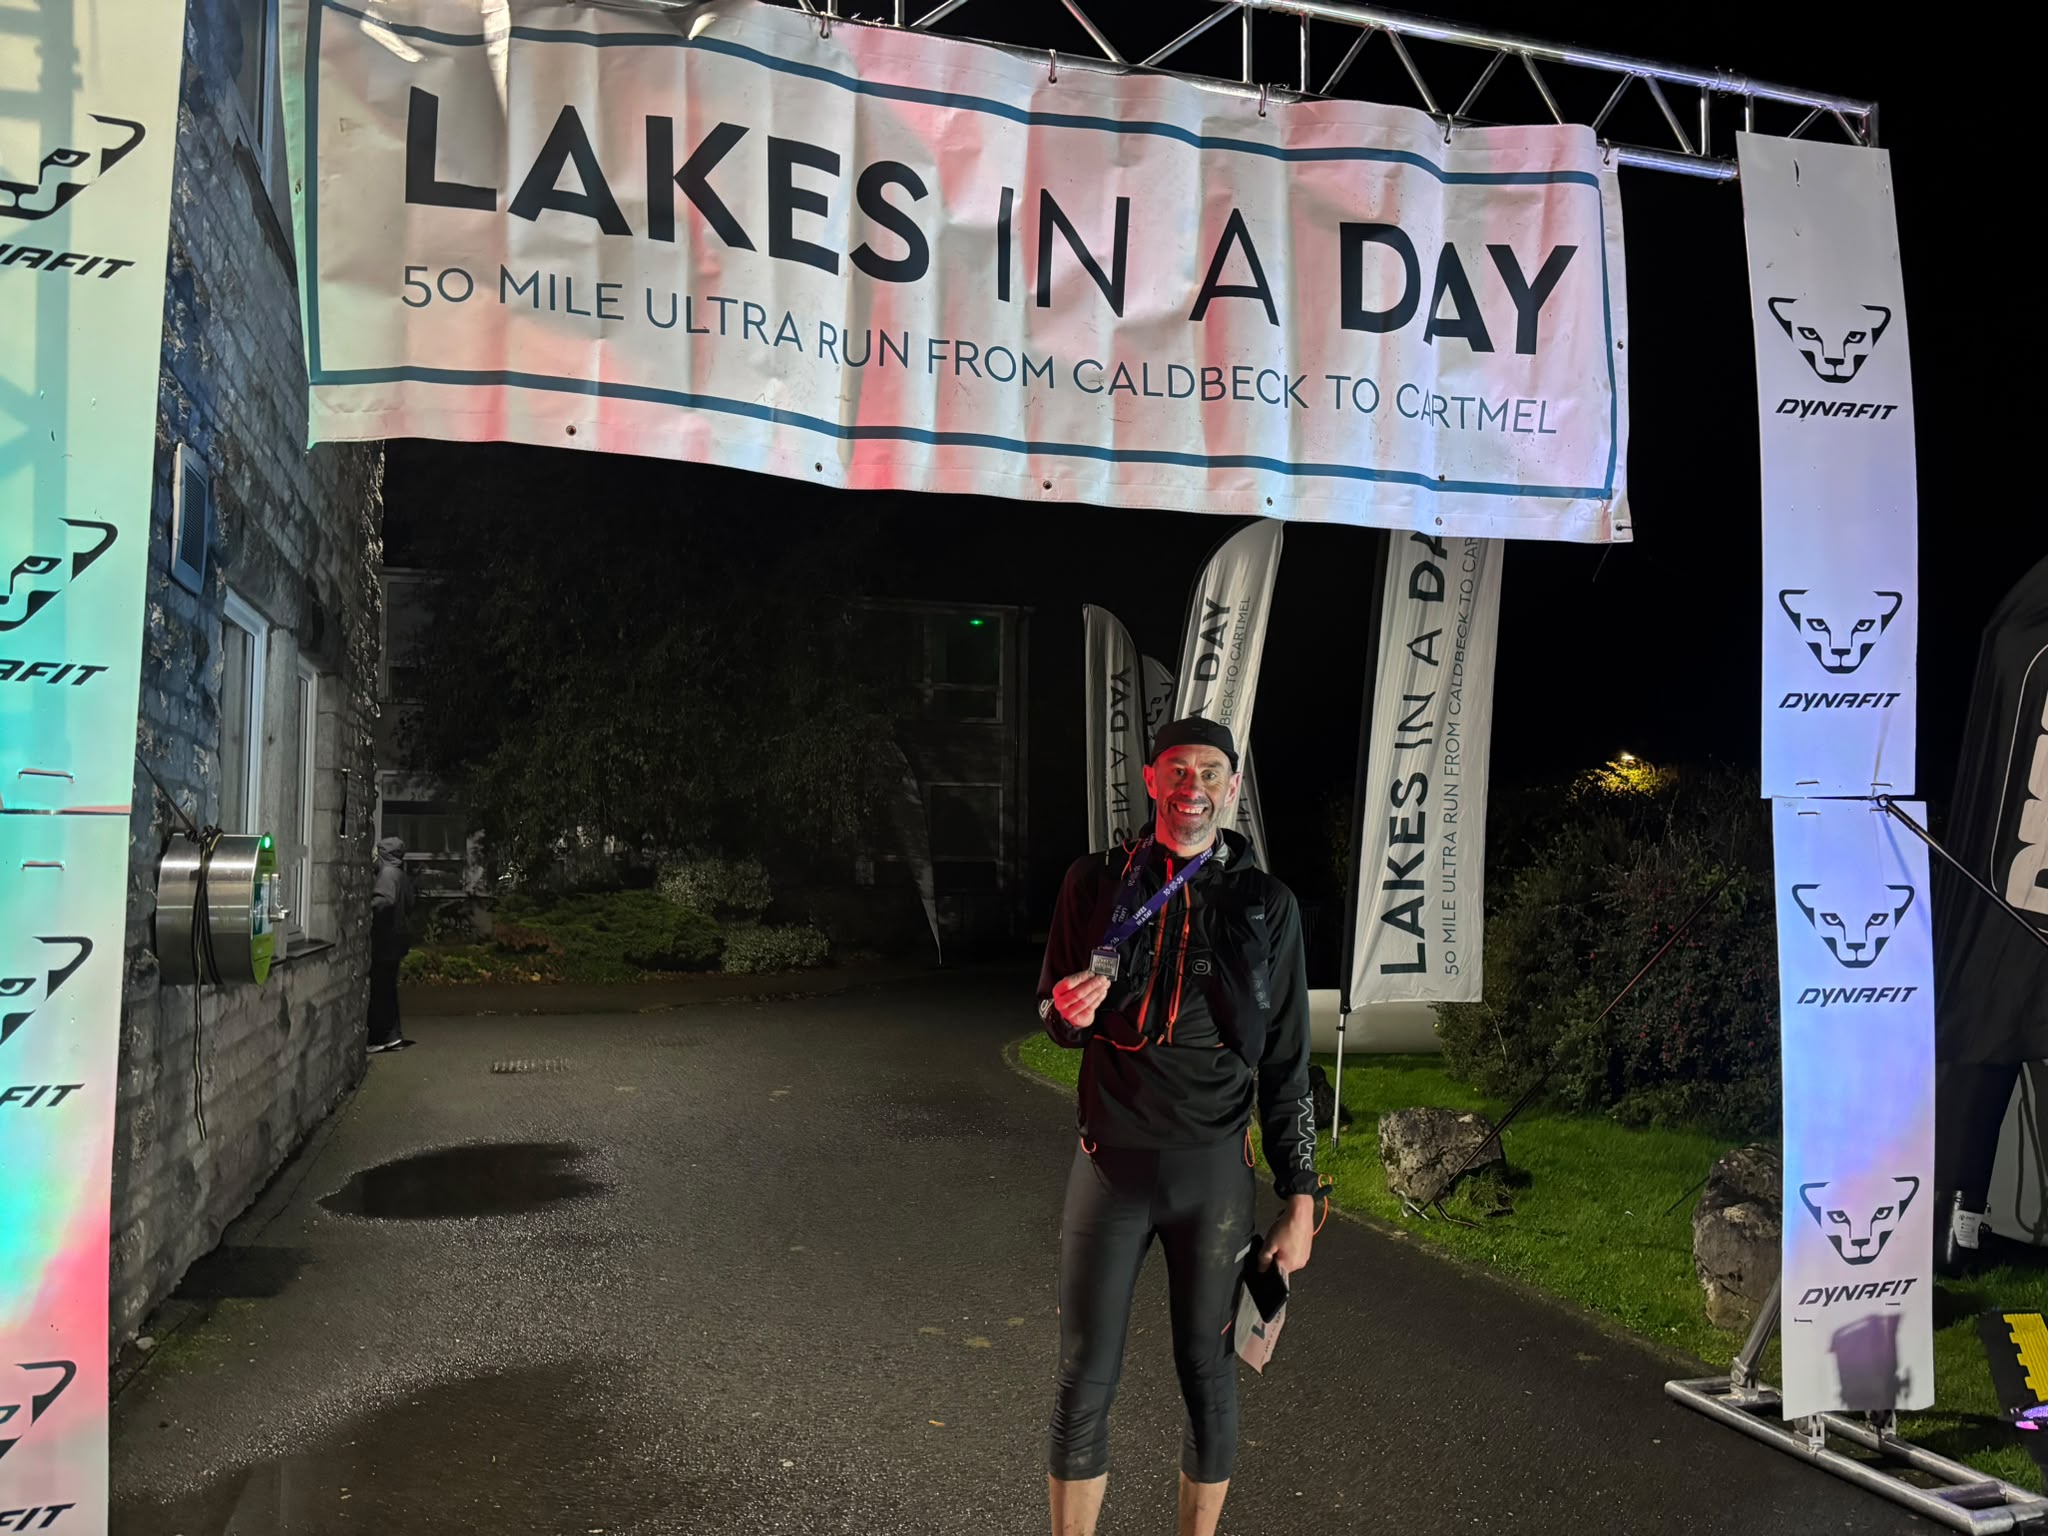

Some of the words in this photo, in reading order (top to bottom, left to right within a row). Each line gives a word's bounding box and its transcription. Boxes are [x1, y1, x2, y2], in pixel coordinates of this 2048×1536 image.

[405, 85, 930, 283] LAKES
[998, 186, 1131, 318] IN
[1189, 208, 1280, 327] A
[1339, 221, 1578, 355] DAY
[0, 243, 136, 279] AFIT
[401, 265, 474, 308] 50
[499, 264, 625, 321] MILE
[645, 287, 803, 353] ULTRA
[818, 319, 910, 369] RUN
[928, 339, 1055, 389] FROM
[1072, 359, 1309, 409] CALDBECK
[1325, 375, 1380, 414] TO
[1396, 383, 1557, 435] CARTMEL
[1776, 398, 1898, 420] DYNAFIT
[1409, 531, 1447, 602] DA
[1463, 537, 1478, 573] CAR
[1459, 579, 1473, 605] TO
[1194, 597, 1230, 682] DAY
[1230, 597, 1251, 661] CARTMEL
[1406, 628, 1442, 666] A
[1226, 664, 1238, 687] TO
[1449, 612, 1468, 715] CALDBECK
[1220, 690, 1235, 725] BECK
[1394, 691, 1436, 749] IN
[1778, 692, 1900, 712] DYNAFIT
[1445, 722, 1461, 776] FROM
[1444, 784, 1459, 824] RUN
[1380, 772, 1428, 974] LAKES
[1442, 831, 1457, 893] ULTRA
[1442, 900, 1456, 943] MILE
[1445, 950, 1459, 975] 50
[1797, 986, 1917, 1007] DYNAFIT
[1798, 1278, 1918, 1307] DYNAFIT
